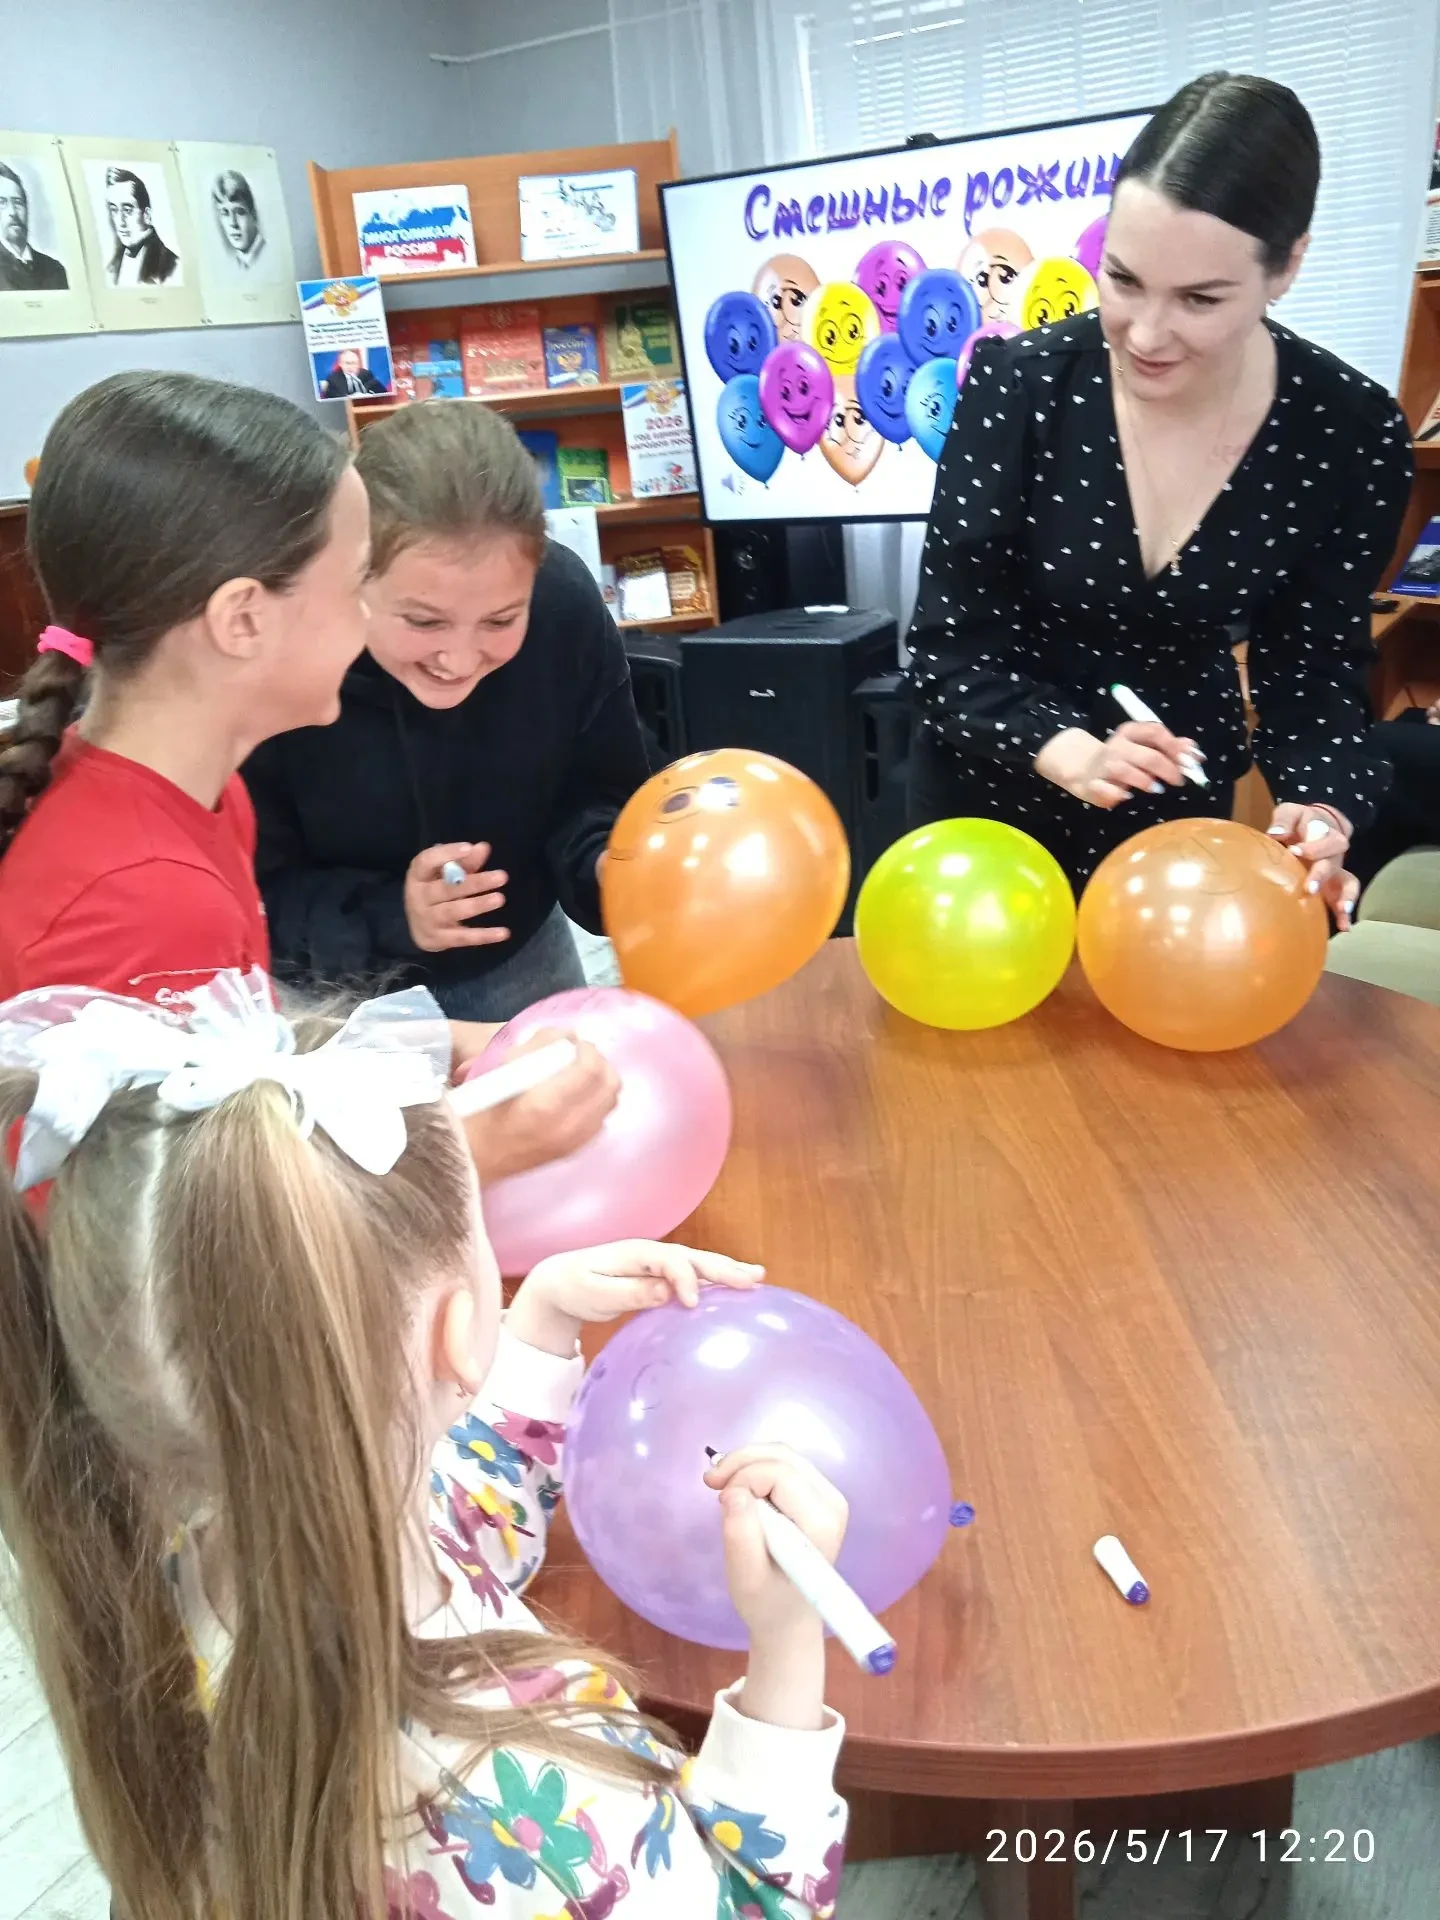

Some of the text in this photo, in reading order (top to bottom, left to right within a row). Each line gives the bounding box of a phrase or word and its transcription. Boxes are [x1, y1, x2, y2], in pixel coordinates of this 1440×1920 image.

[745, 177, 951, 242] Смешные
[383, 240, 438, 258] РОССИЯ
[646, 414, 683, 430] 2026
